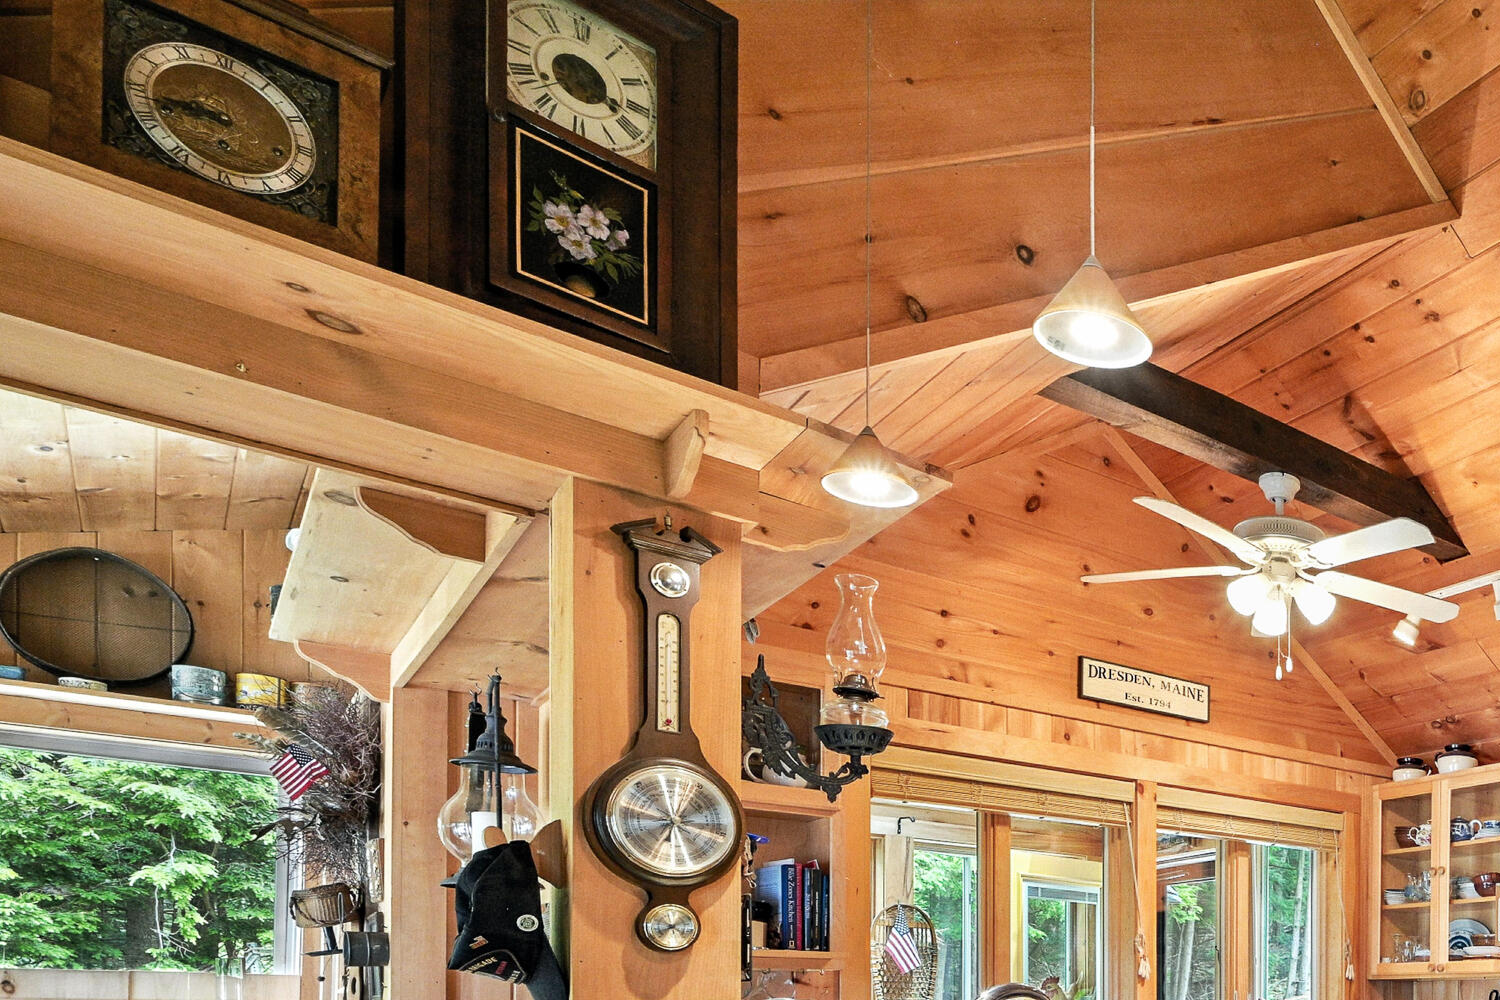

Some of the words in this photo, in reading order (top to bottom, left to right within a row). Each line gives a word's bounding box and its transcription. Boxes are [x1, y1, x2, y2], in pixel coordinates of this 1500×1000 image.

[1088, 664, 1155, 688] DRESDEN,
[1160, 680, 1205, 703] MAINE
[1124, 692, 1144, 703] Est.
[1149, 697, 1171, 709] 1794
[787, 881, 795, 899] Zones
